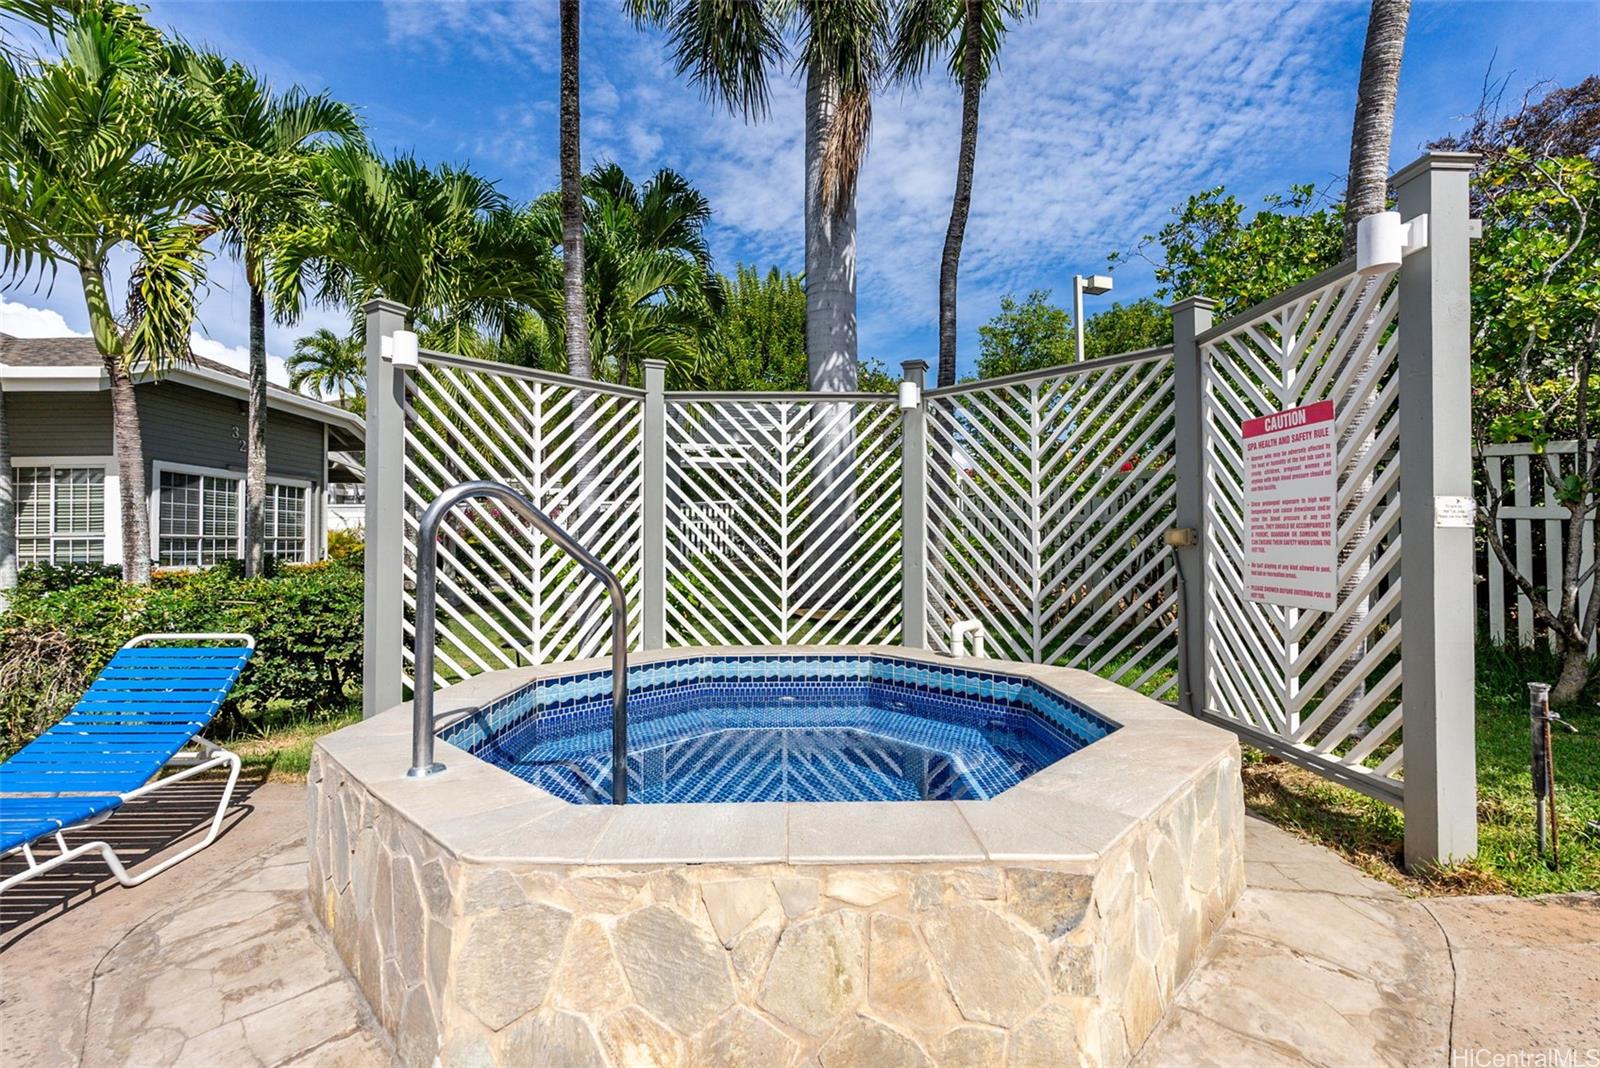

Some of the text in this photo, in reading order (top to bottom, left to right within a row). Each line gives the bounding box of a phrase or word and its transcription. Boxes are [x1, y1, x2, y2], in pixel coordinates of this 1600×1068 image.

[1265, 409, 1306, 432] CAUTION
[232, 426, 240, 438] 3
[1258, 440, 1277, 448] HEALTH
[1279, 436, 1290, 444] AND
[1292, 432, 1311, 442] SAFETY
[1314, 428, 1328, 437] RULE
[240, 440, 246, 452] 2
